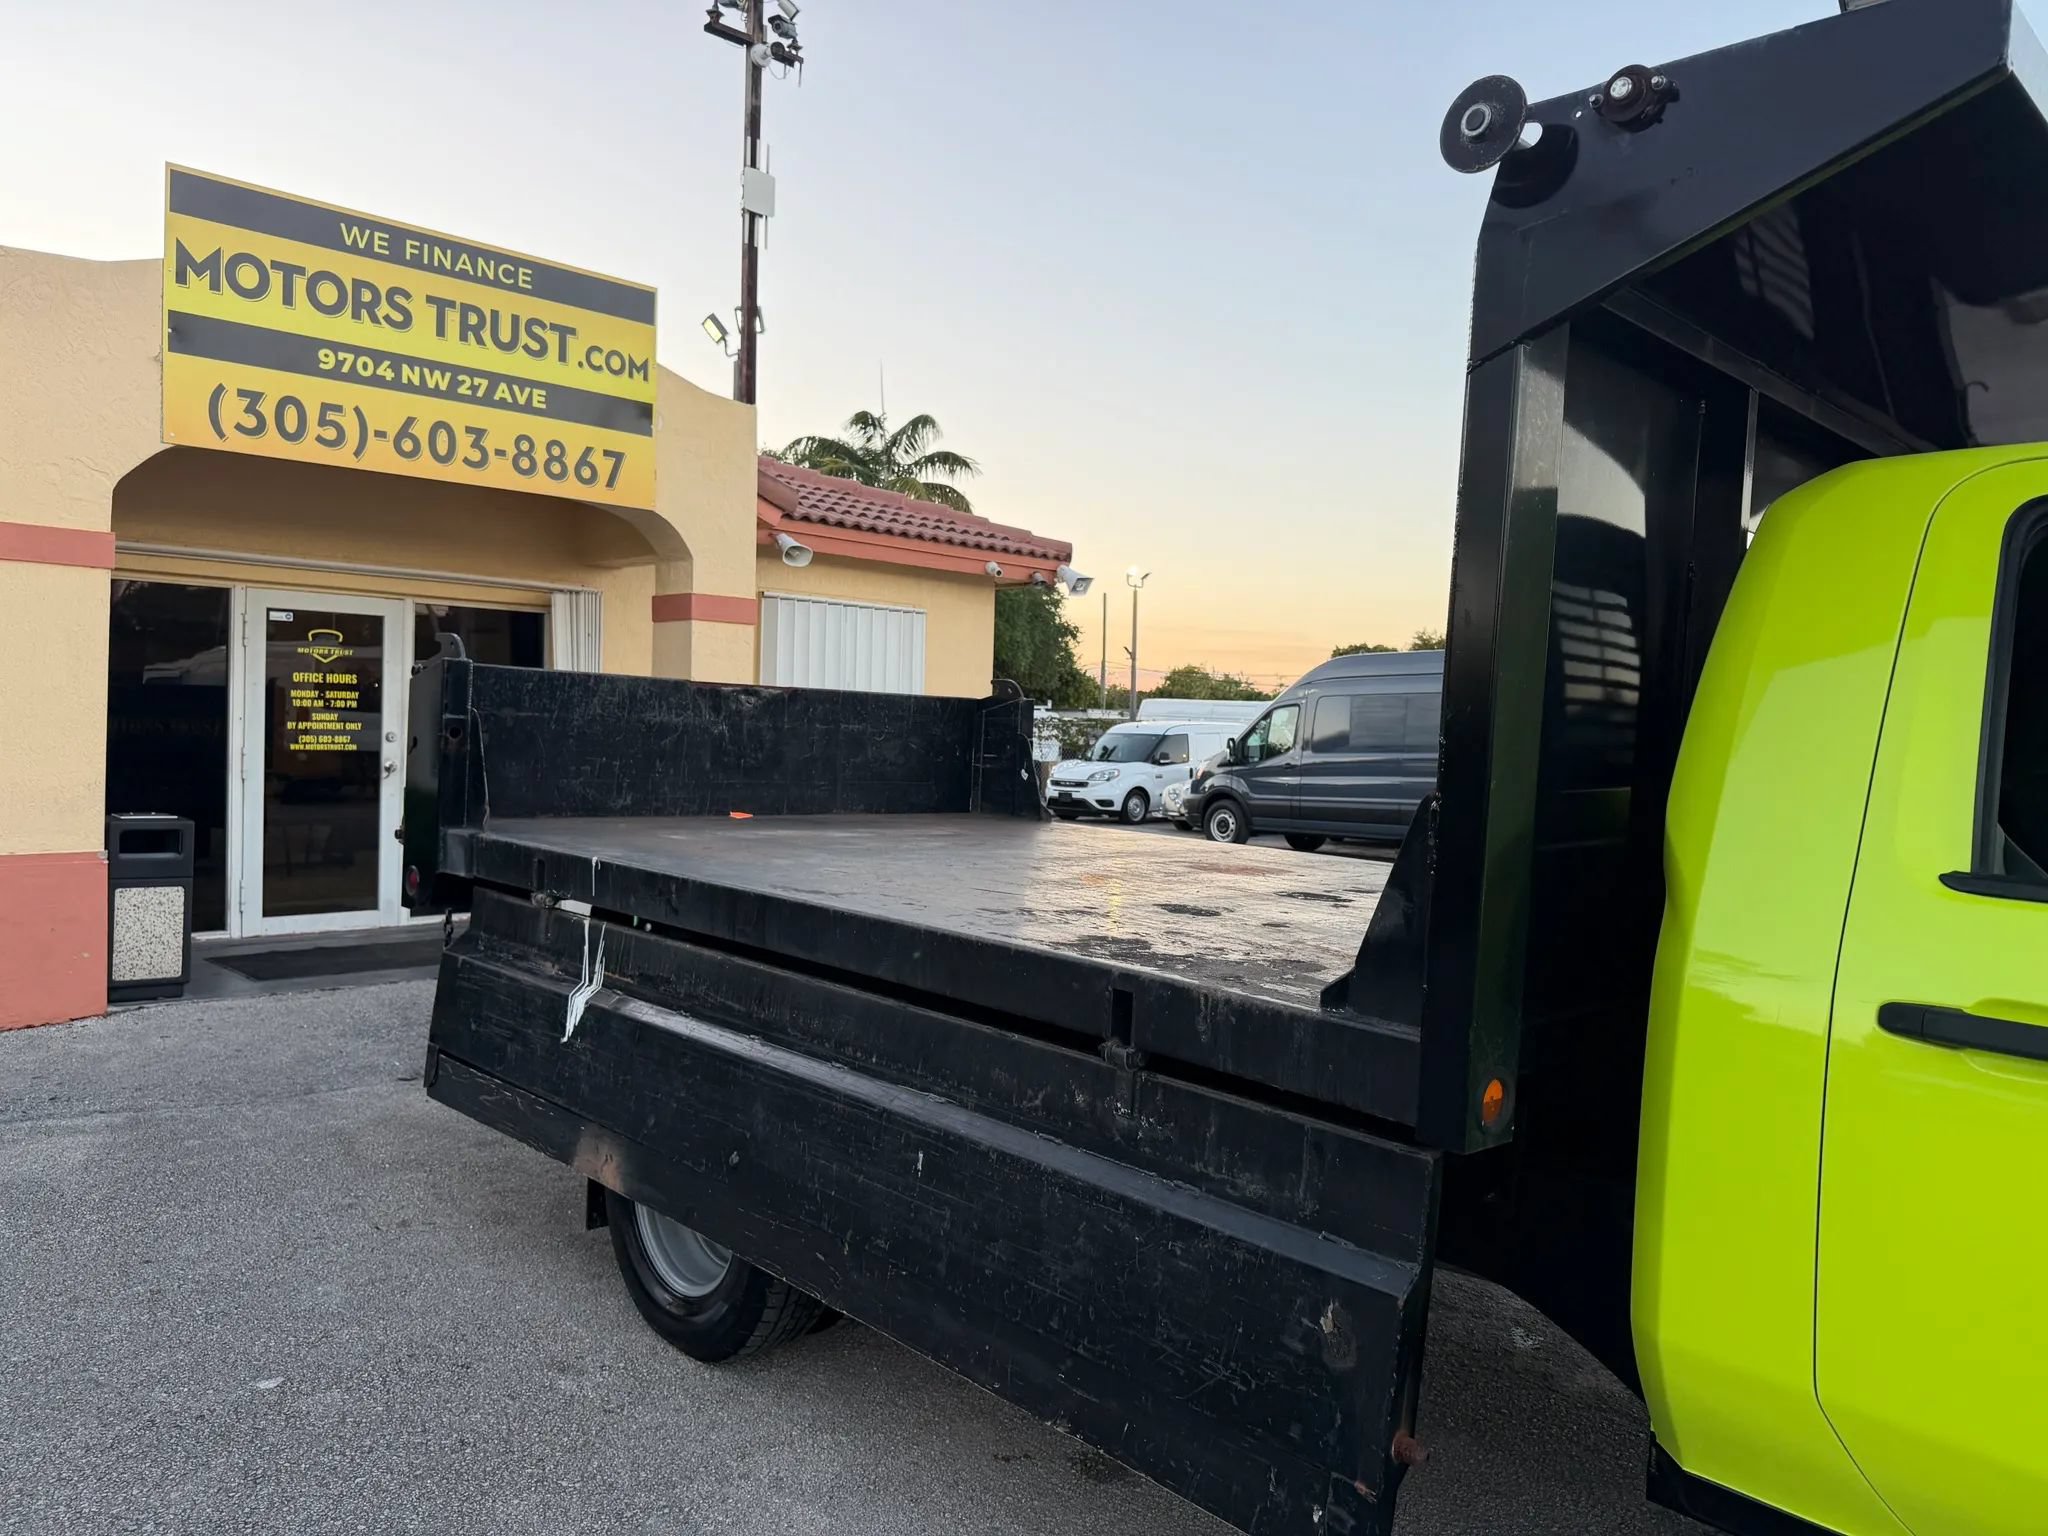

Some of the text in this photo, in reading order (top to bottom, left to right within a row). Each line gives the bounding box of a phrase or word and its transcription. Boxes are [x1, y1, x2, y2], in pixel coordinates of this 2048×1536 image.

[340, 222, 533, 290] WE FINANCE
[175, 237, 413, 331] MOTORS
[318, 348, 547, 409] 9704 NW 27 AVE
[207, 382, 627, 491] (305)-603-8867
[290, 689, 319, 698] MONDAY
[325, 690, 359, 699] SATURDAY
[293, 672, 358, 684] OFFICE HOURS
[292, 699, 312, 707] 10:00
[313, 699, 324, 707] AM
[346, 700, 357, 708] PM
[287, 721, 362, 730] BY APPOINTMENT ONLY
